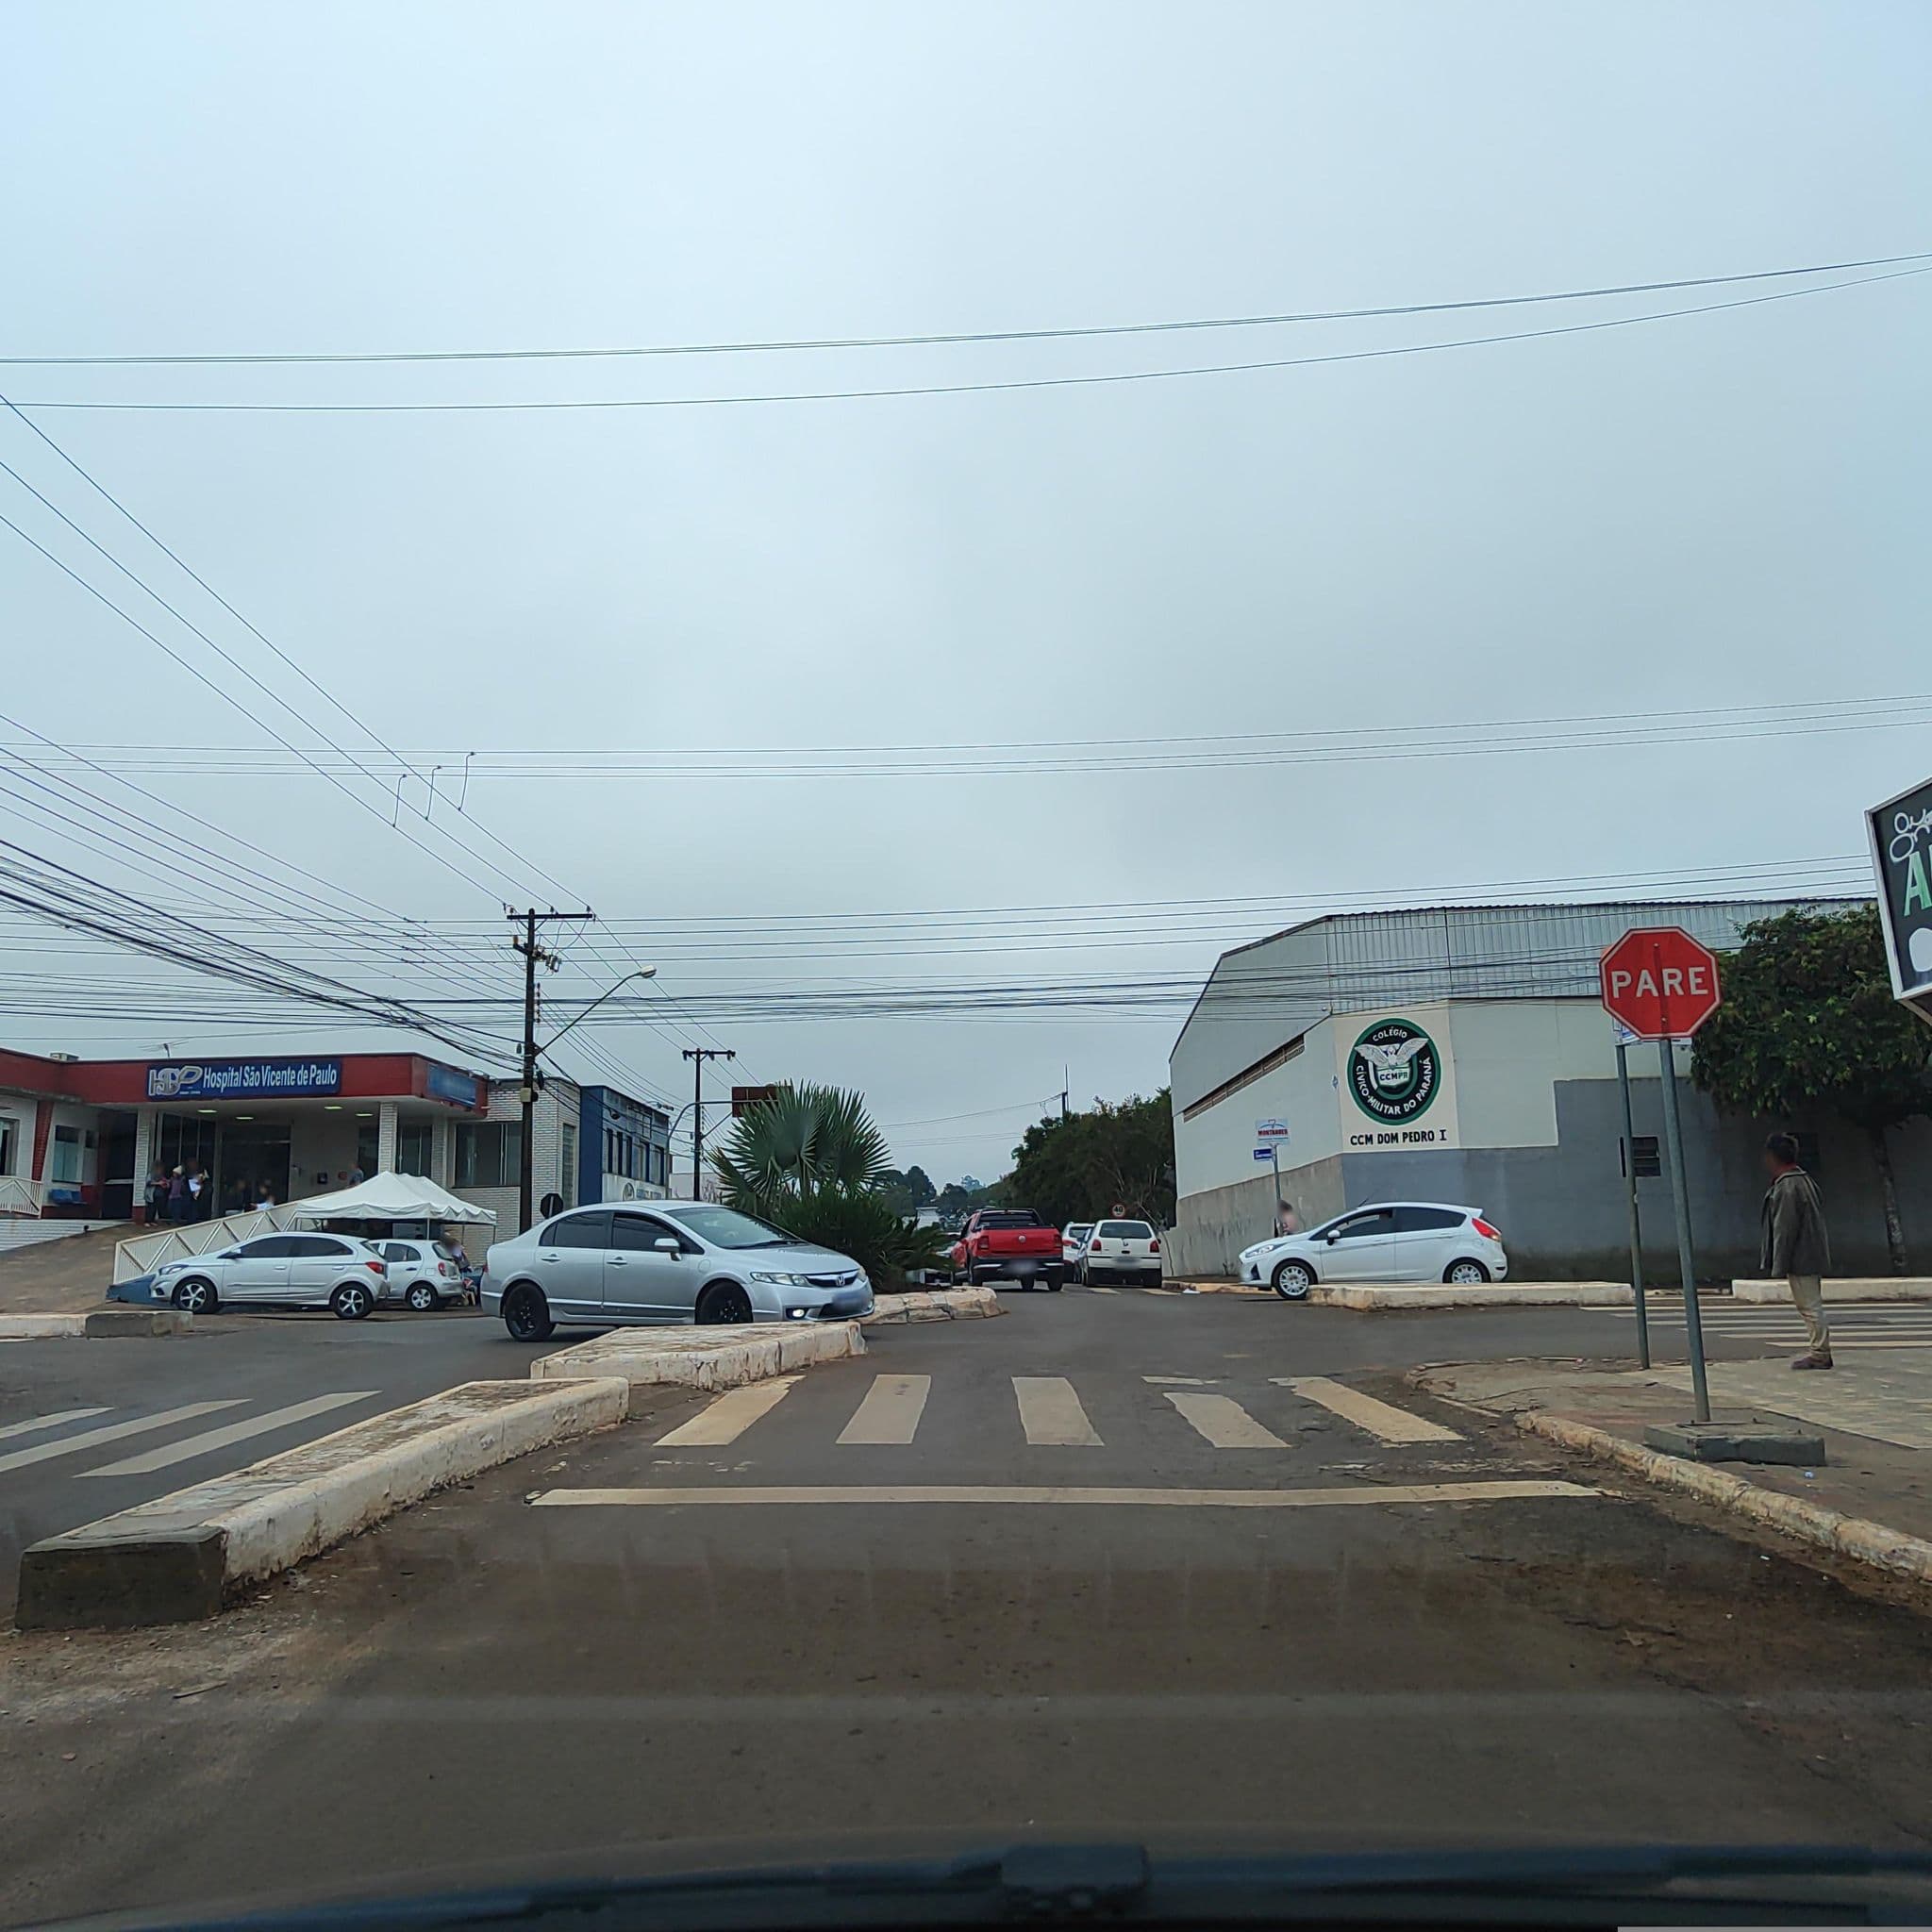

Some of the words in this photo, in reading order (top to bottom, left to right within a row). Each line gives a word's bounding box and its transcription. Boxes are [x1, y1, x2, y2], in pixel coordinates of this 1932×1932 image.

[1611, 966, 1709, 999] PARE
[1373, 1026, 1407, 1041] COLÉGIO
[203, 1066, 242, 1093] Hospital
[242, 1065, 260, 1086] São
[260, 1065, 295, 1087] Vicente
[297, 1064, 308, 1086] de
[308, 1063, 337, 1085] Paulo
[1403, 1100, 1417, 1113] DO
[1415, 1057, 1432, 1102] PARANÁ
[1350, 1134, 1374, 1145] CCM
[1377, 1132, 1399, 1144] DOM
[1402, 1130, 1435, 1143] PEDRO
[1439, 1129, 1447, 1141] I
